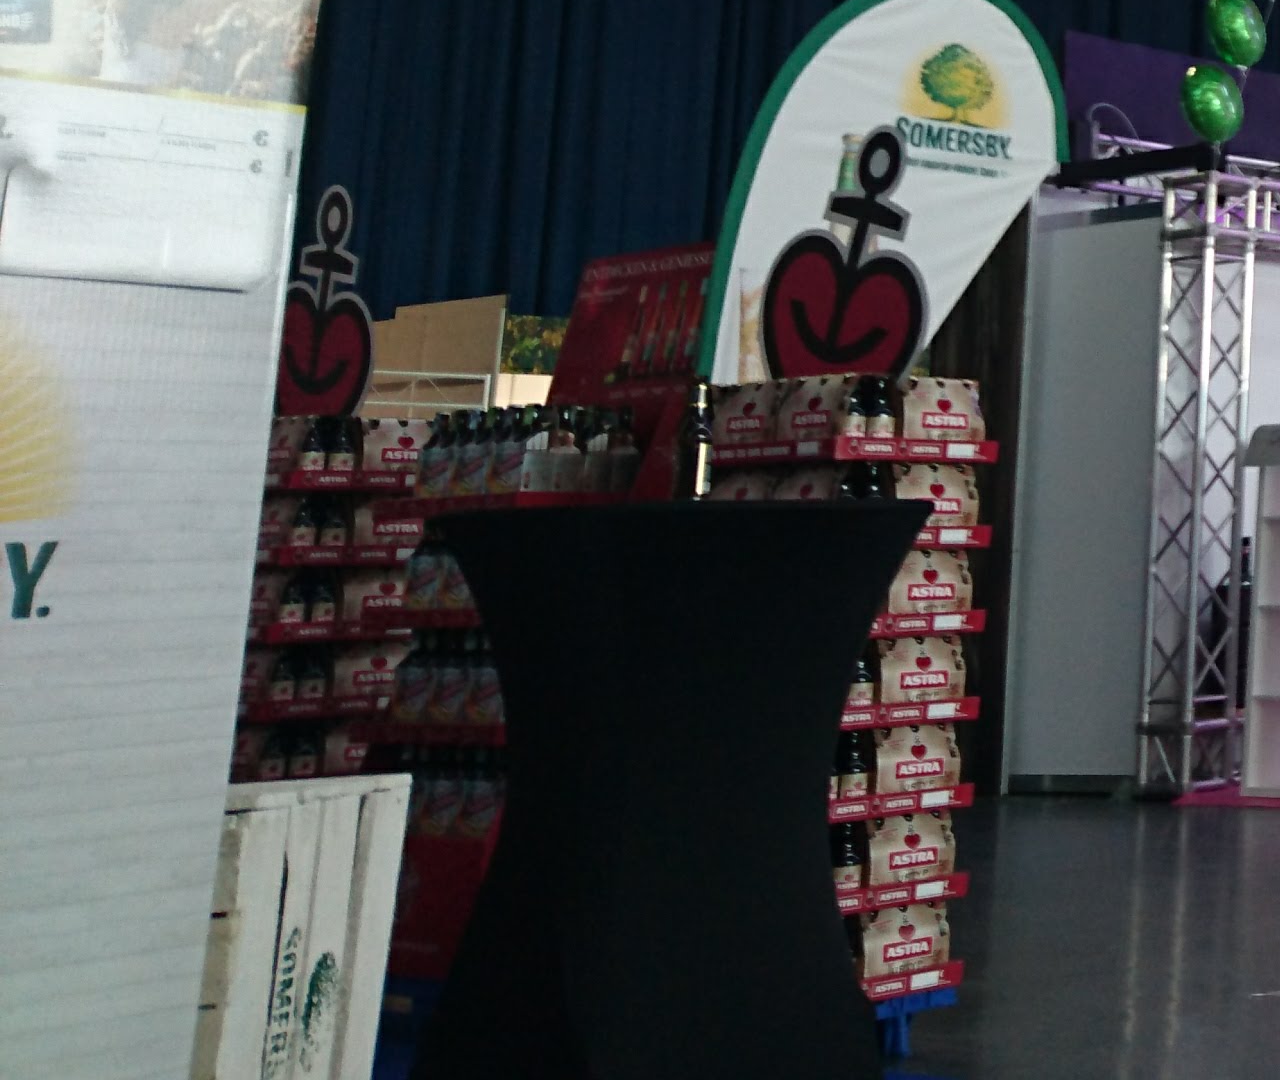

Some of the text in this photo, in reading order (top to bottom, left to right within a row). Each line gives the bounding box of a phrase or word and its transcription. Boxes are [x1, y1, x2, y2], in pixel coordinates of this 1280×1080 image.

[925, 416, 966, 427] ASTRA
[384, 450, 418, 460] ASTR
[933, 501, 959, 512] TRA
[911, 587, 953, 598] ASTRA
[366, 598, 403, 607] ASTR
[358, 672, 395, 681] ASTR
[904, 673, 946, 686] ASTRA
[900, 761, 941, 775] ASTRA
[892, 850, 935, 866] ASTRA
[886, 941, 929, 958] ASTRA
